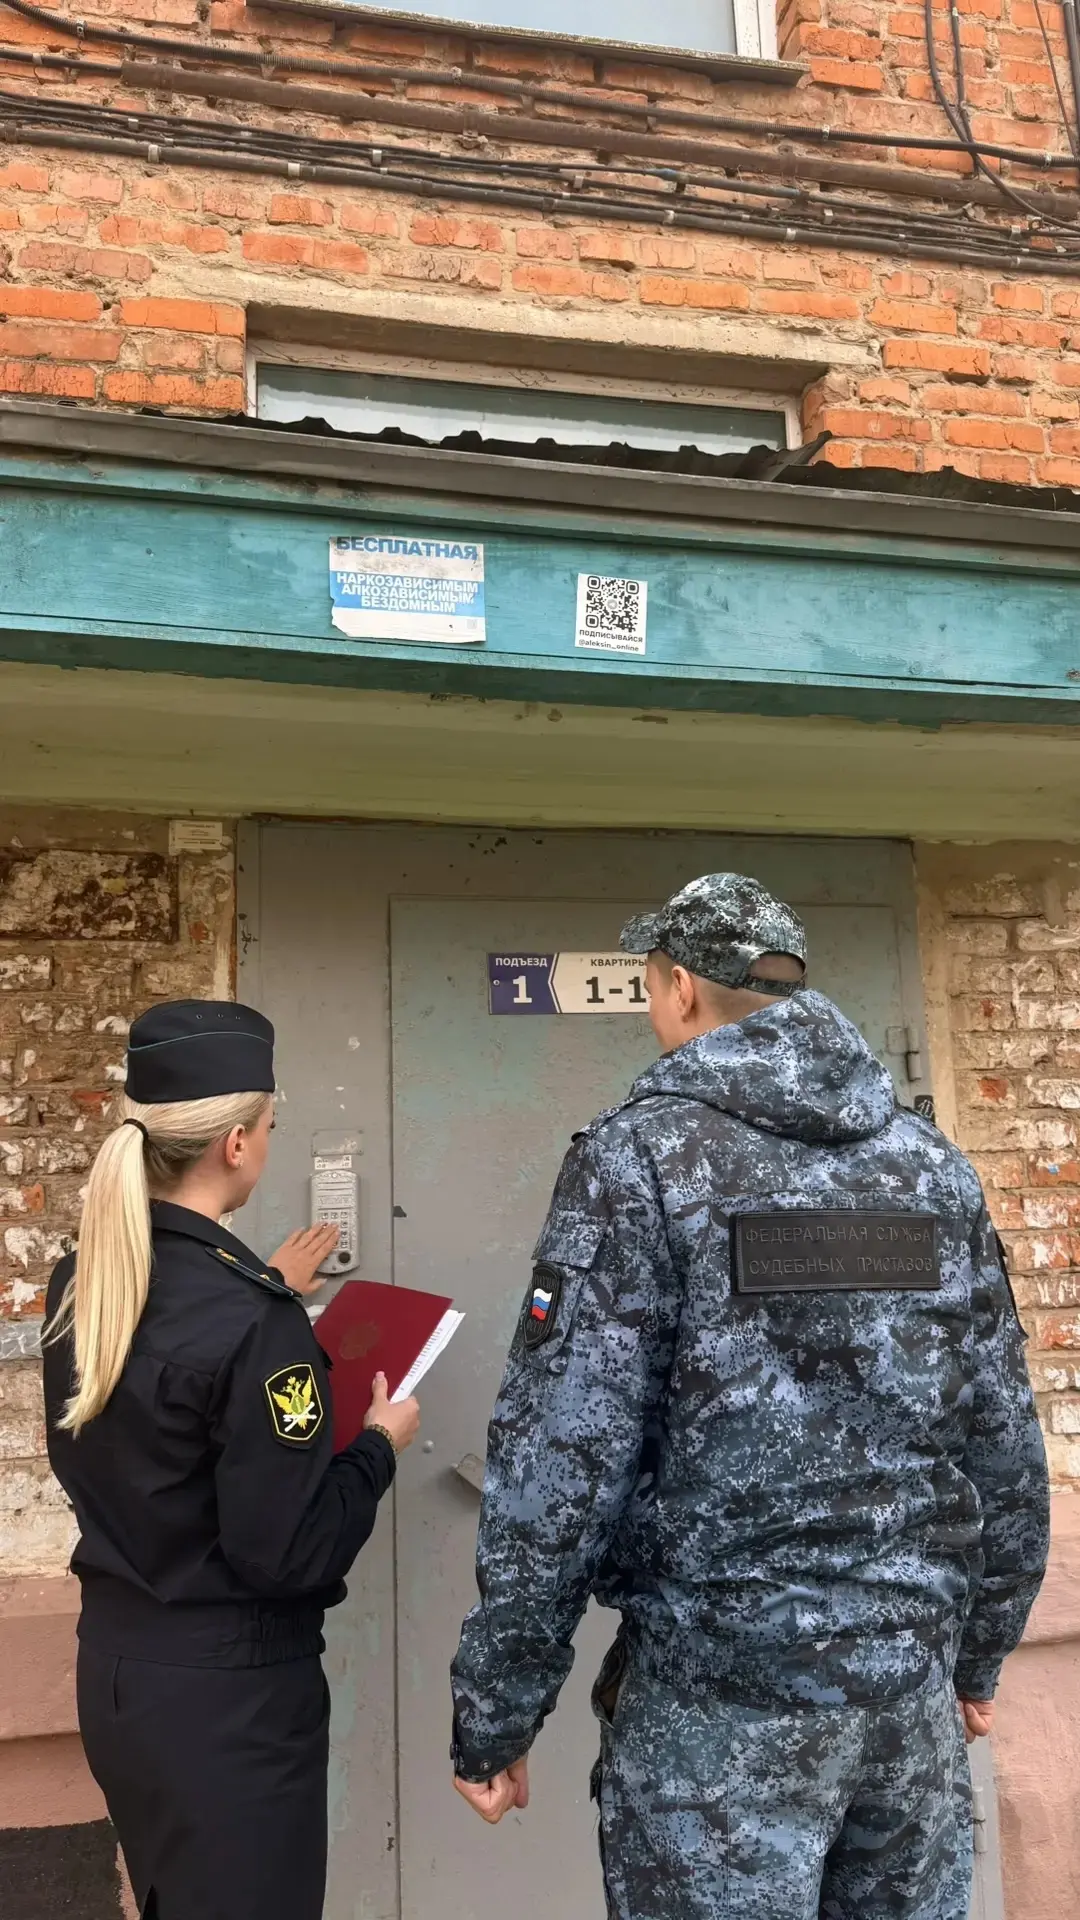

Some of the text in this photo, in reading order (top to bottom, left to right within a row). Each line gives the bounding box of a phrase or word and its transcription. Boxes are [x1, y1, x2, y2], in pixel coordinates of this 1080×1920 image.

[336, 536, 478, 560] БЕСПЛАТНАЯ
[336, 572, 478, 593] НАРКОЗАВИСИМЫМ
[361, 595, 456, 613] БЕЗДОМНЫМ
[579, 629, 643, 643] ПОДПИСЫВАЙСЯ
[578, 639, 640, 652] @aleksin_online
[495, 957, 548, 968] ПОДЪЕЗД
[590, 958, 648, 967] КВАРТИРЫ
[512, 975, 533, 1004] 1
[746, 1225, 932, 1244] ФЕДЕРАЛЬНАЯ СЛУЖБА
[749, 1256, 933, 1276] СУДЕБНЫХ ПРИСТАВОВ
